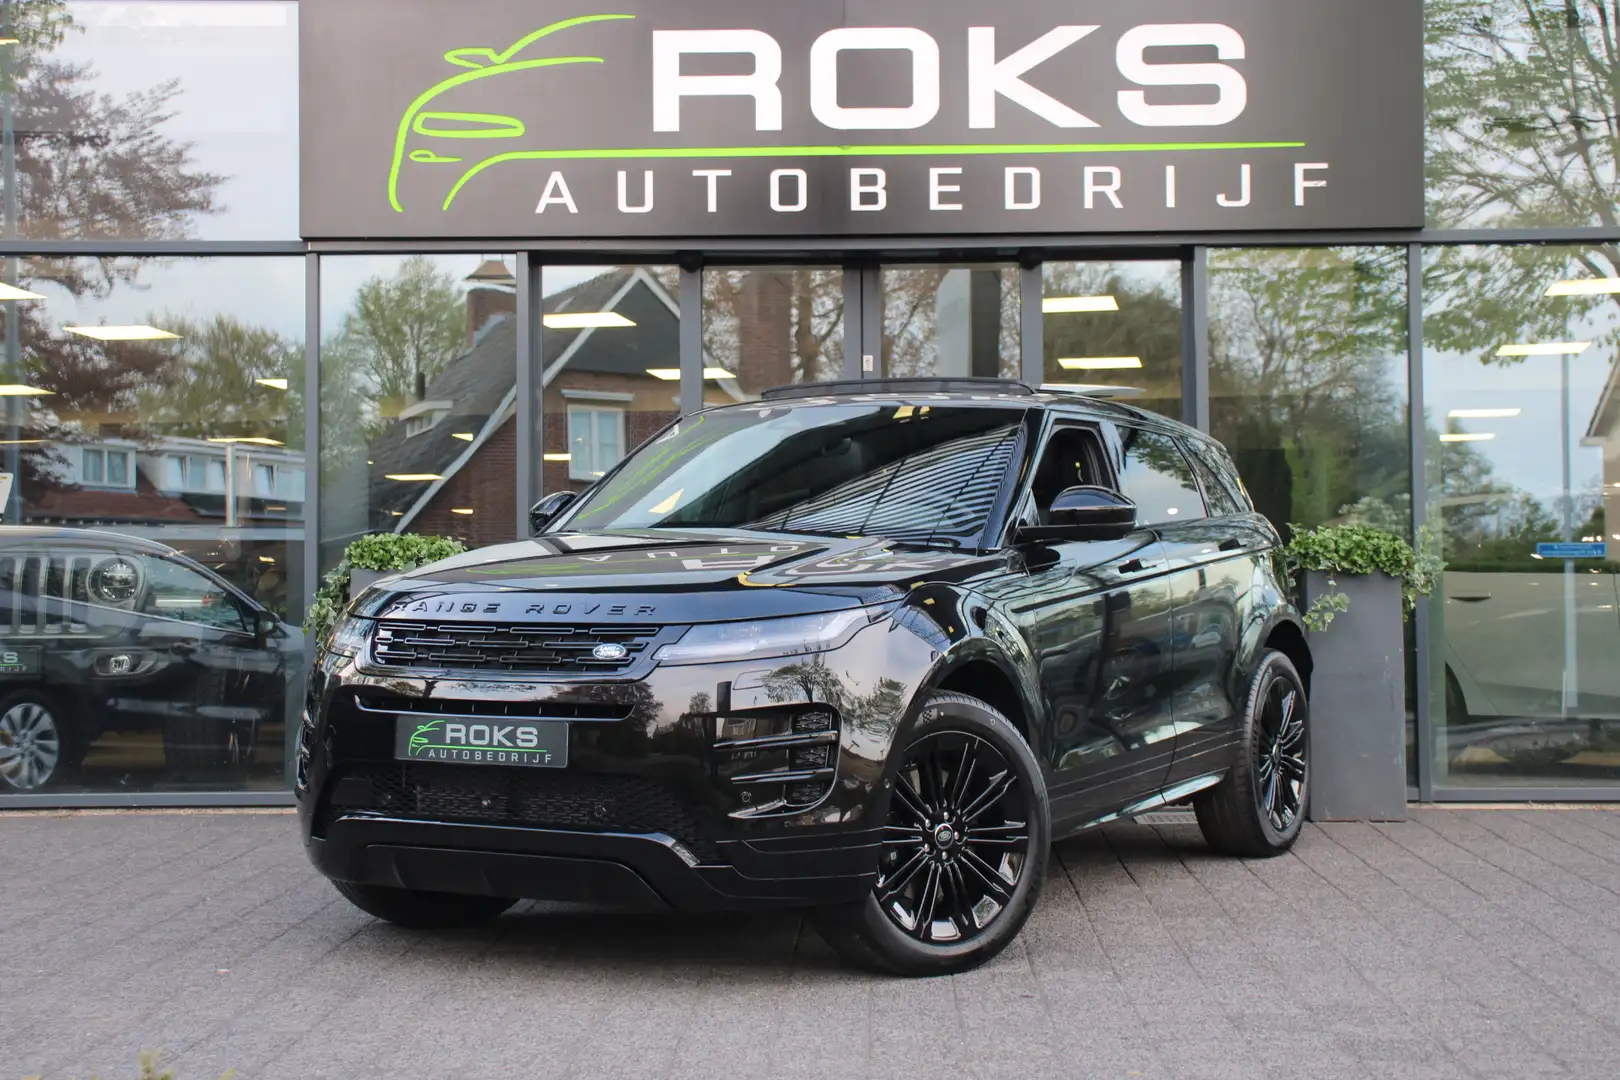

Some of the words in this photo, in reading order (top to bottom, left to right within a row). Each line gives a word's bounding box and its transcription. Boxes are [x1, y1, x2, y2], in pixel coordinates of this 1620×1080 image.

[652, 22, 1248, 133] ROKS
[533, 162, 1330, 215] AUTOBEDRIJF
[391, 600, 500, 614] RANGE
[525, 603, 657, 616] ROVER
[445, 723, 539, 748] ROKS
[428, 749, 552, 764] AUTOBEDRIJF
